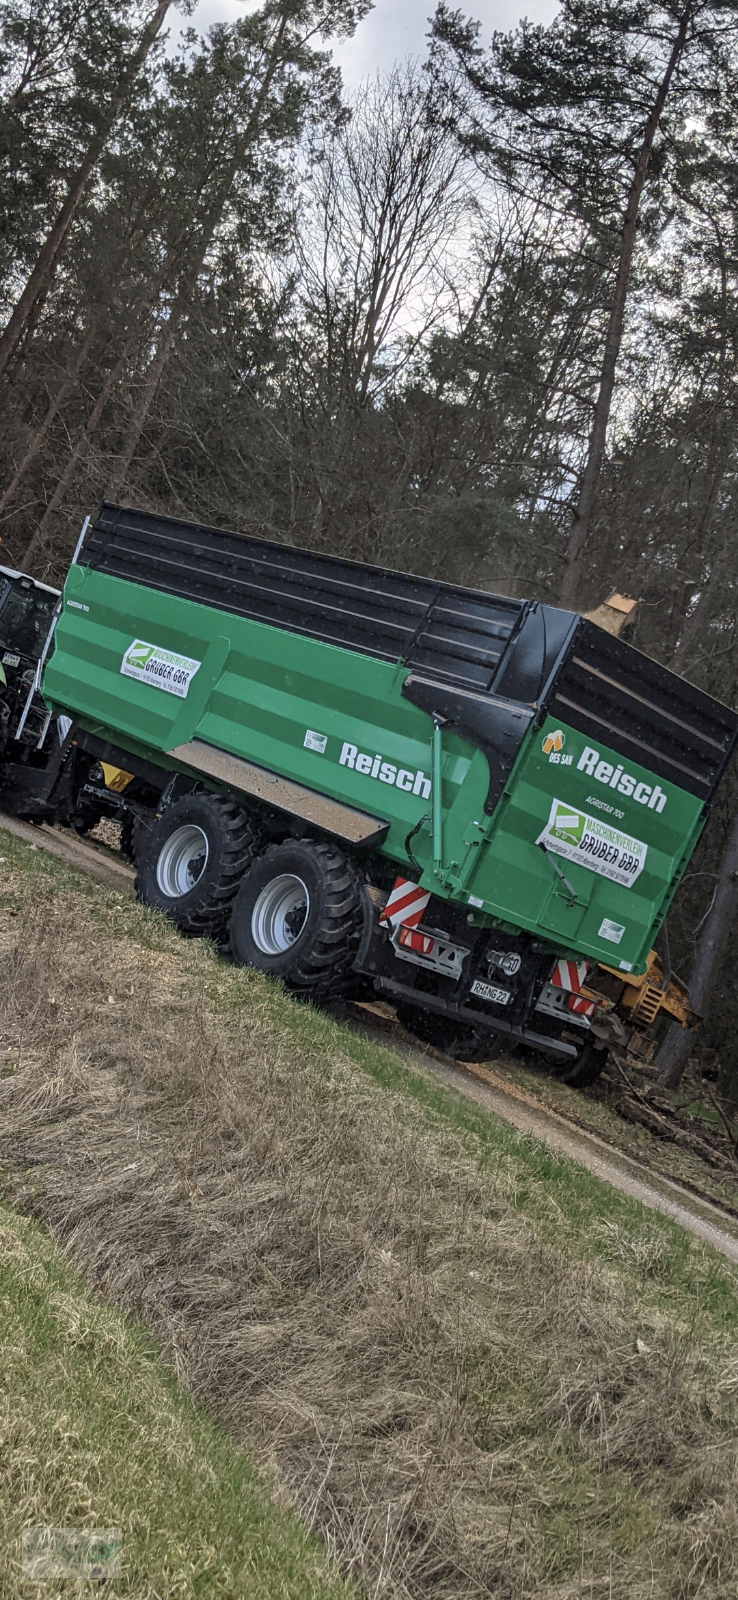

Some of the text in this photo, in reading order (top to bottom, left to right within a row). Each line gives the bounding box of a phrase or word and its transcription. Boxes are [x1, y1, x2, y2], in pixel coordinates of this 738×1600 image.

[145, 659, 175, 680] GRUBER
[172, 669, 190, 686] GBR
[339, 742, 432, 799] Reisch
[549, 752, 574, 766] DES SAN
[576, 746, 667, 813] Reisch
[585, 796, 625, 819] AGRISTAR 700
[586, 818, 643, 857] MASCHINENVERLEIH
[579, 834, 640, 875] GRUBER GBR
[474, 982, 486, 994] RH
[496, 991, 507, 1002] 22
